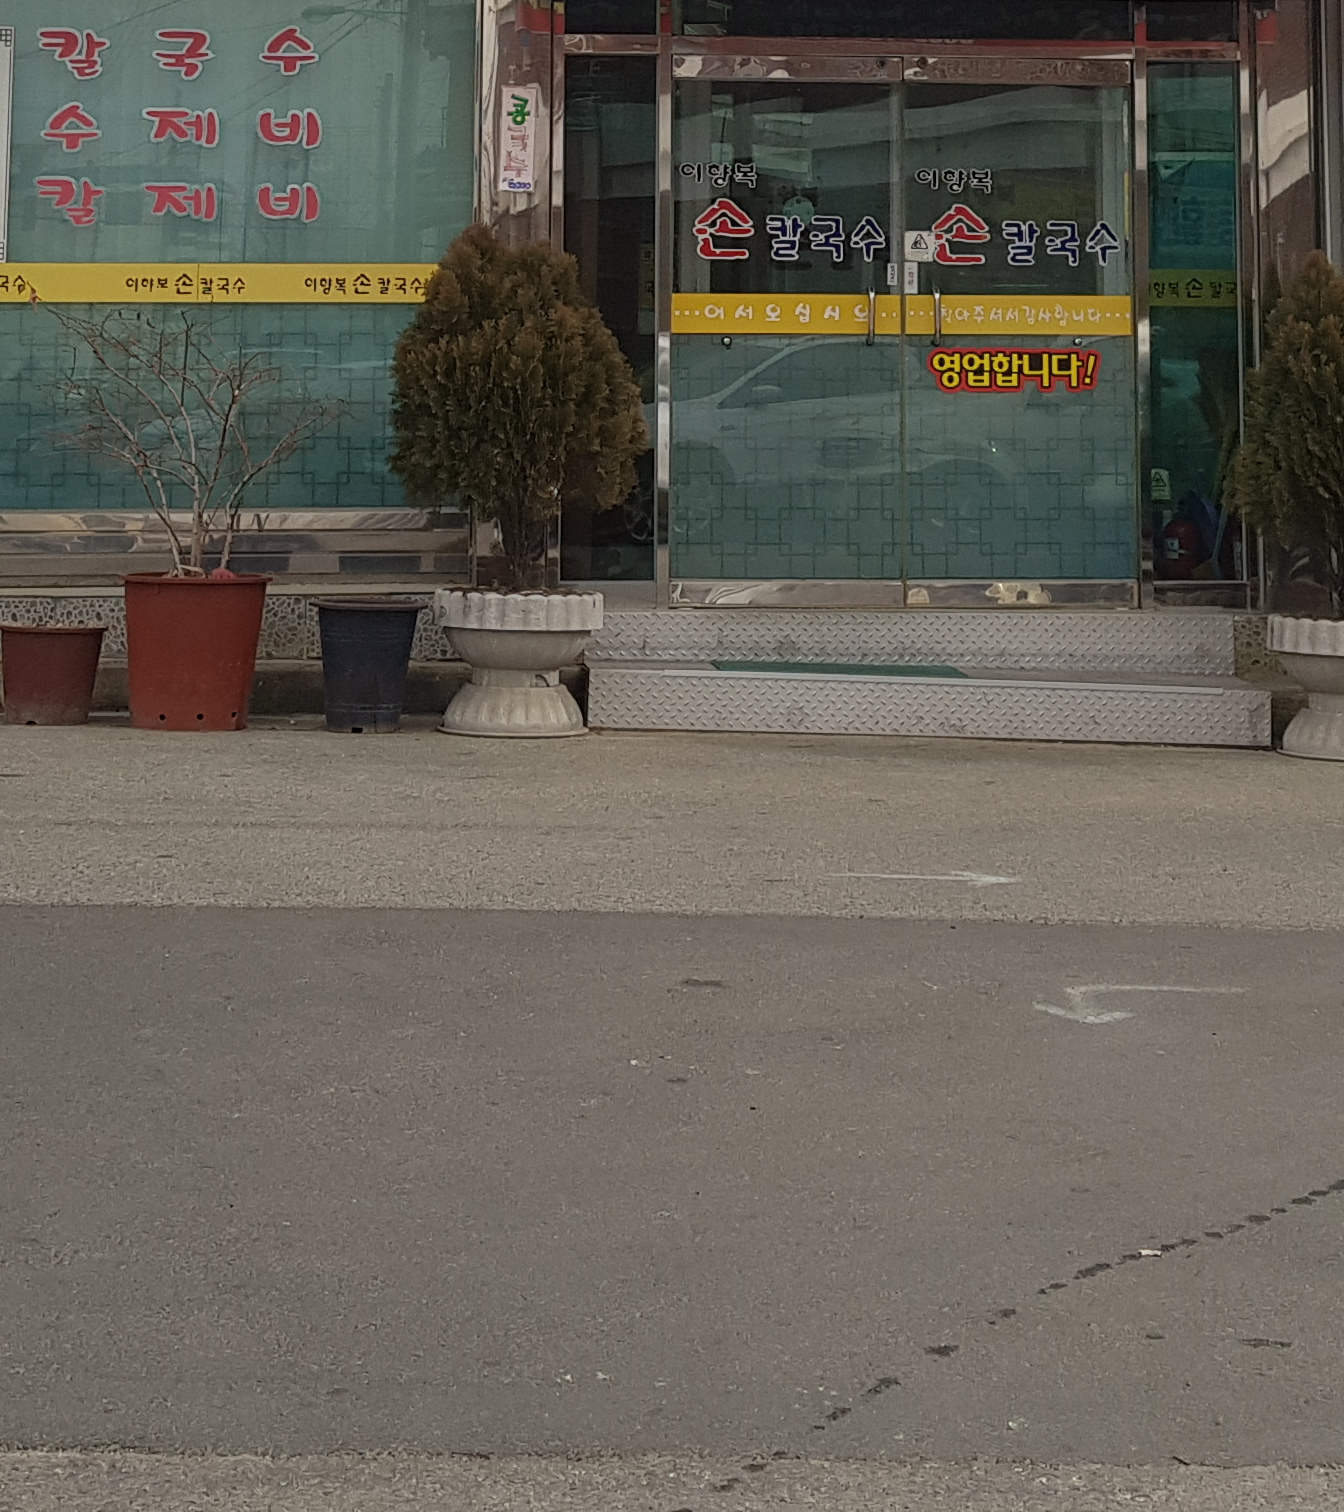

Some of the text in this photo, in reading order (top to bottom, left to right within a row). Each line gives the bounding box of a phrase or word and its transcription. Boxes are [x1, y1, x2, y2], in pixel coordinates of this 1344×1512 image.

[680, 163, 757, 188] 이향복
[916, 168, 993, 194] 이향복
[693, 198, 886, 262] 손 칼국수
[932, 203, 1120, 266] 손 칼국수
[931, 352, 1098, 388] 영업합니다!
